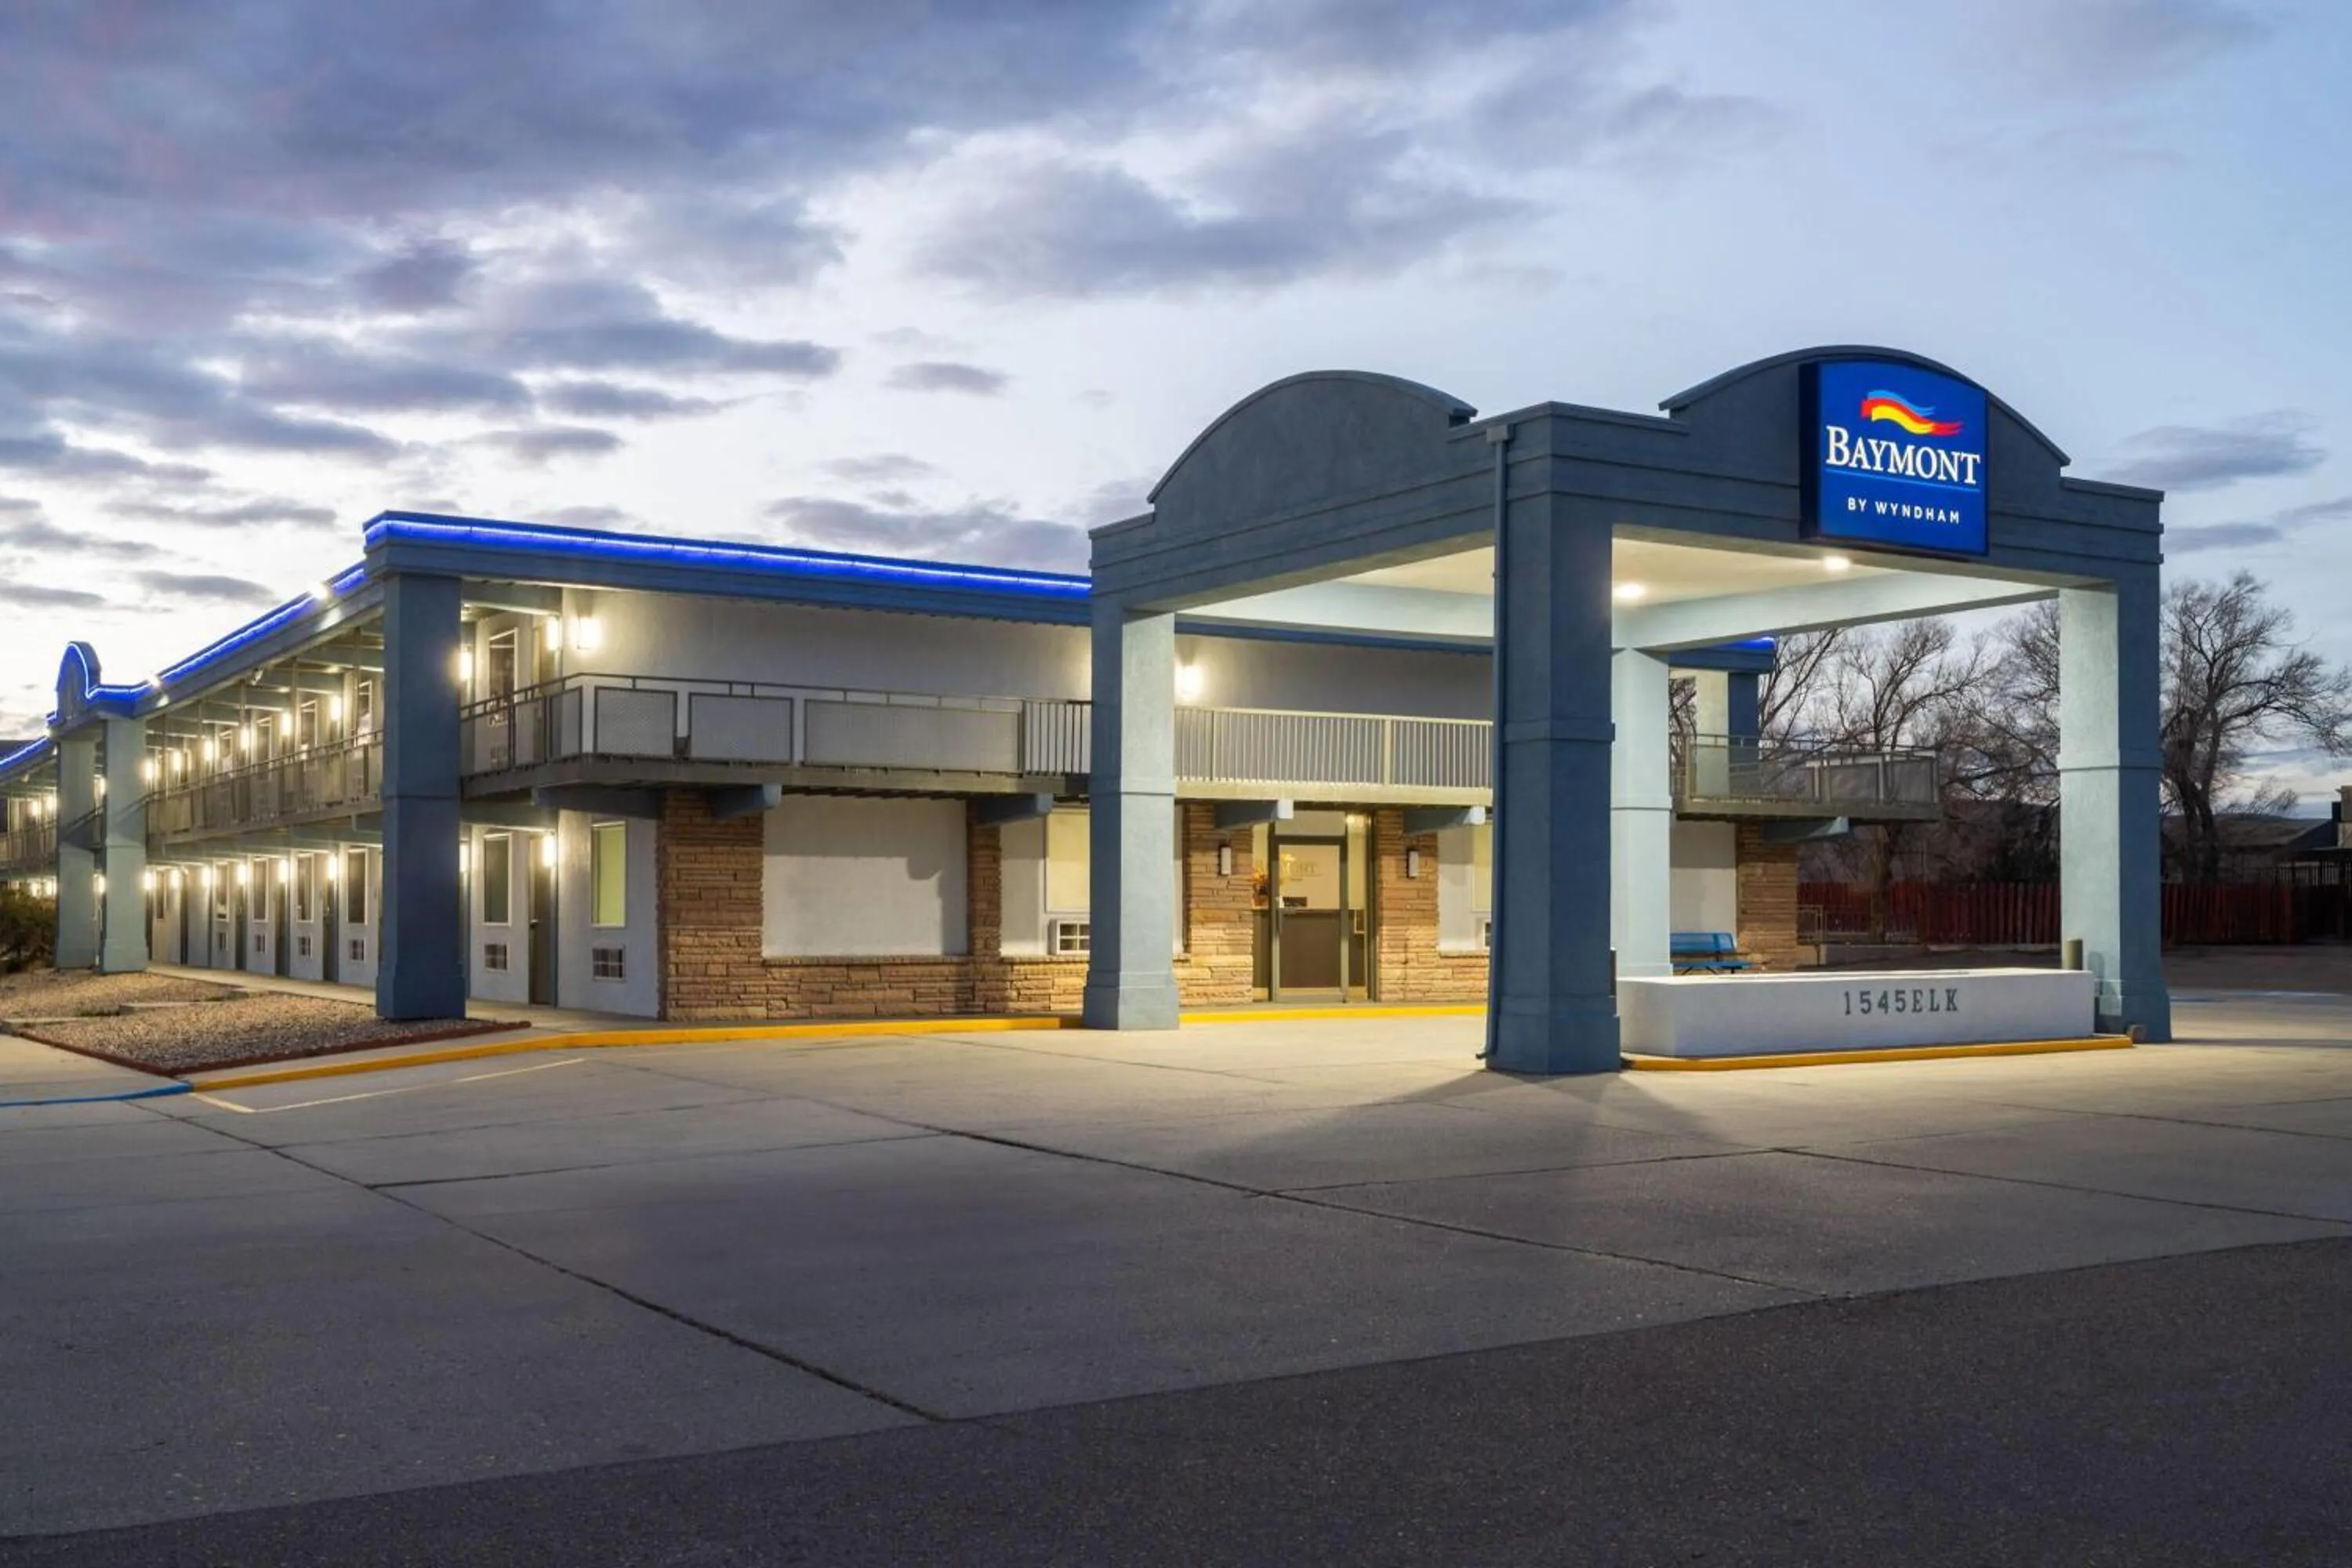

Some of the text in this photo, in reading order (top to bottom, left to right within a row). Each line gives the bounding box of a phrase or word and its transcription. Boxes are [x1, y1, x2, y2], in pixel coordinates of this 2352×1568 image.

[1826, 425, 1980, 485] BAYMONT
[1848, 497, 1959, 524] BY WYNDHAM
